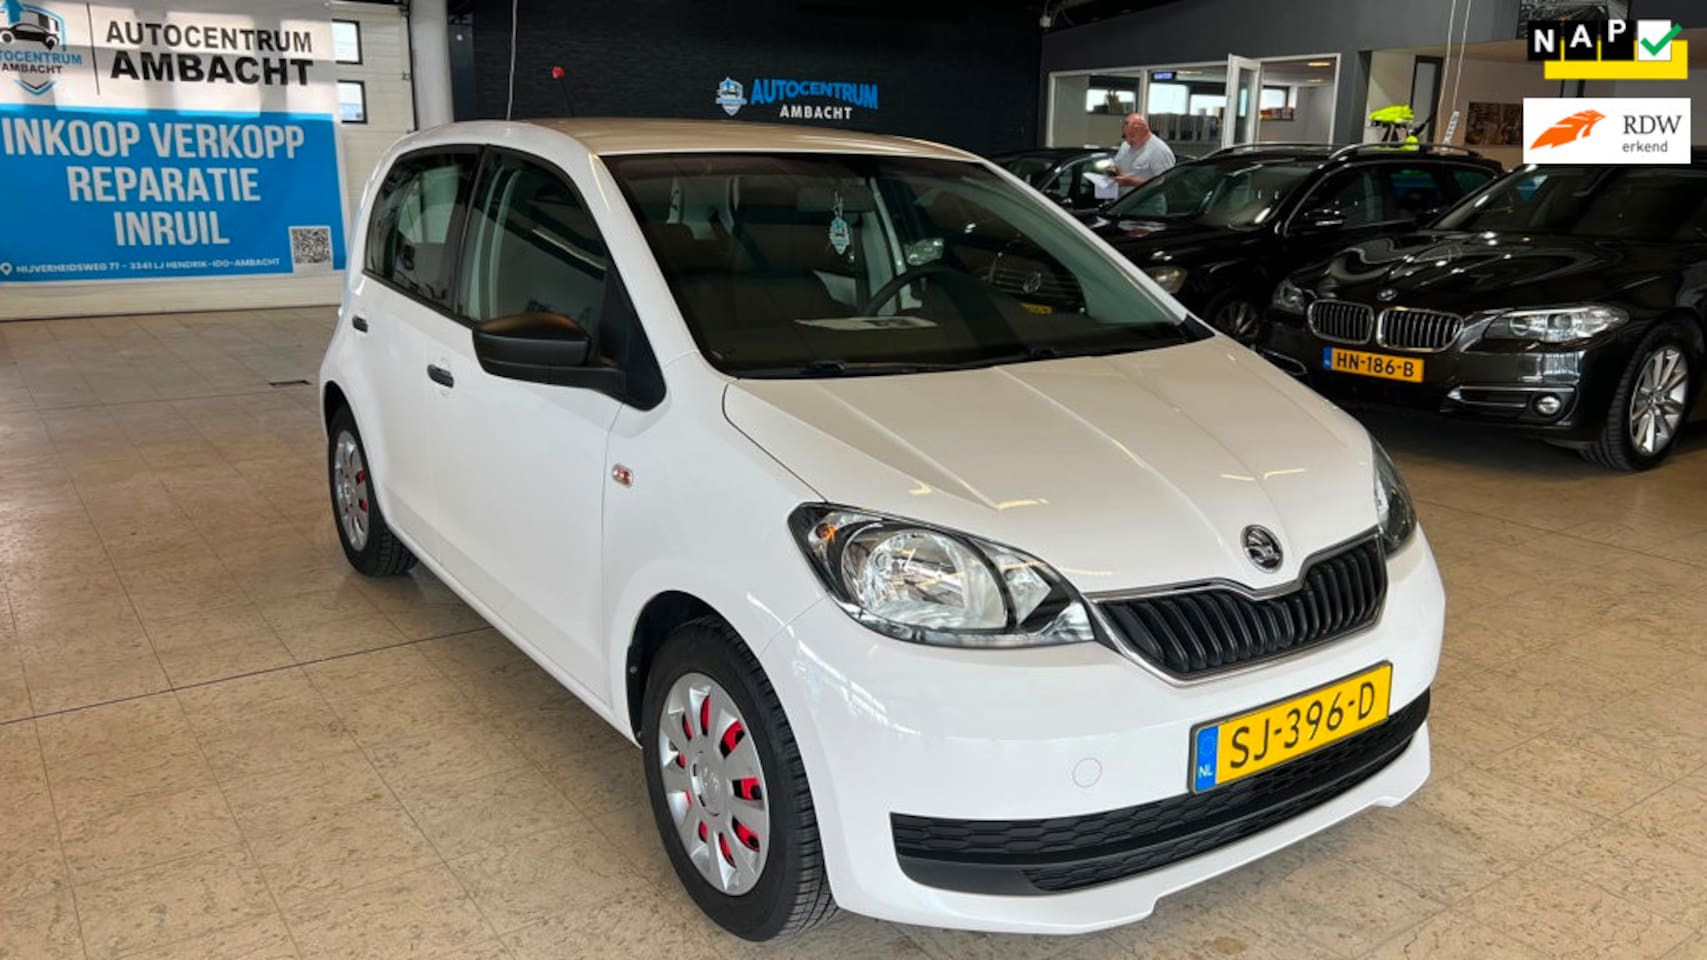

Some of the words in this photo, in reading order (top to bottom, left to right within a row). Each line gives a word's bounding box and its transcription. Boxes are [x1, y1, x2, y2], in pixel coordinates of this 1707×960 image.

[106, 21, 312, 53] AUTOCENTRUM
[2, 63, 63, 74] AMBACHT
[110, 50, 314, 86] AMBACHT
[751, 79, 879, 109] AUTOCENTRUM
[779, 104, 853, 120] AMBACHT
[1, 118, 141, 157] INKOOP
[148, 123, 305, 159] VERKOPP
[66, 166, 261, 202] REPARATIE
[113, 211, 231, 246] INRUIL
[1336, 351, 1414, 377] HN-186-B
[1230, 681, 1375, 769] SJ-396-D
[1199, 763, 1213, 778] NL
